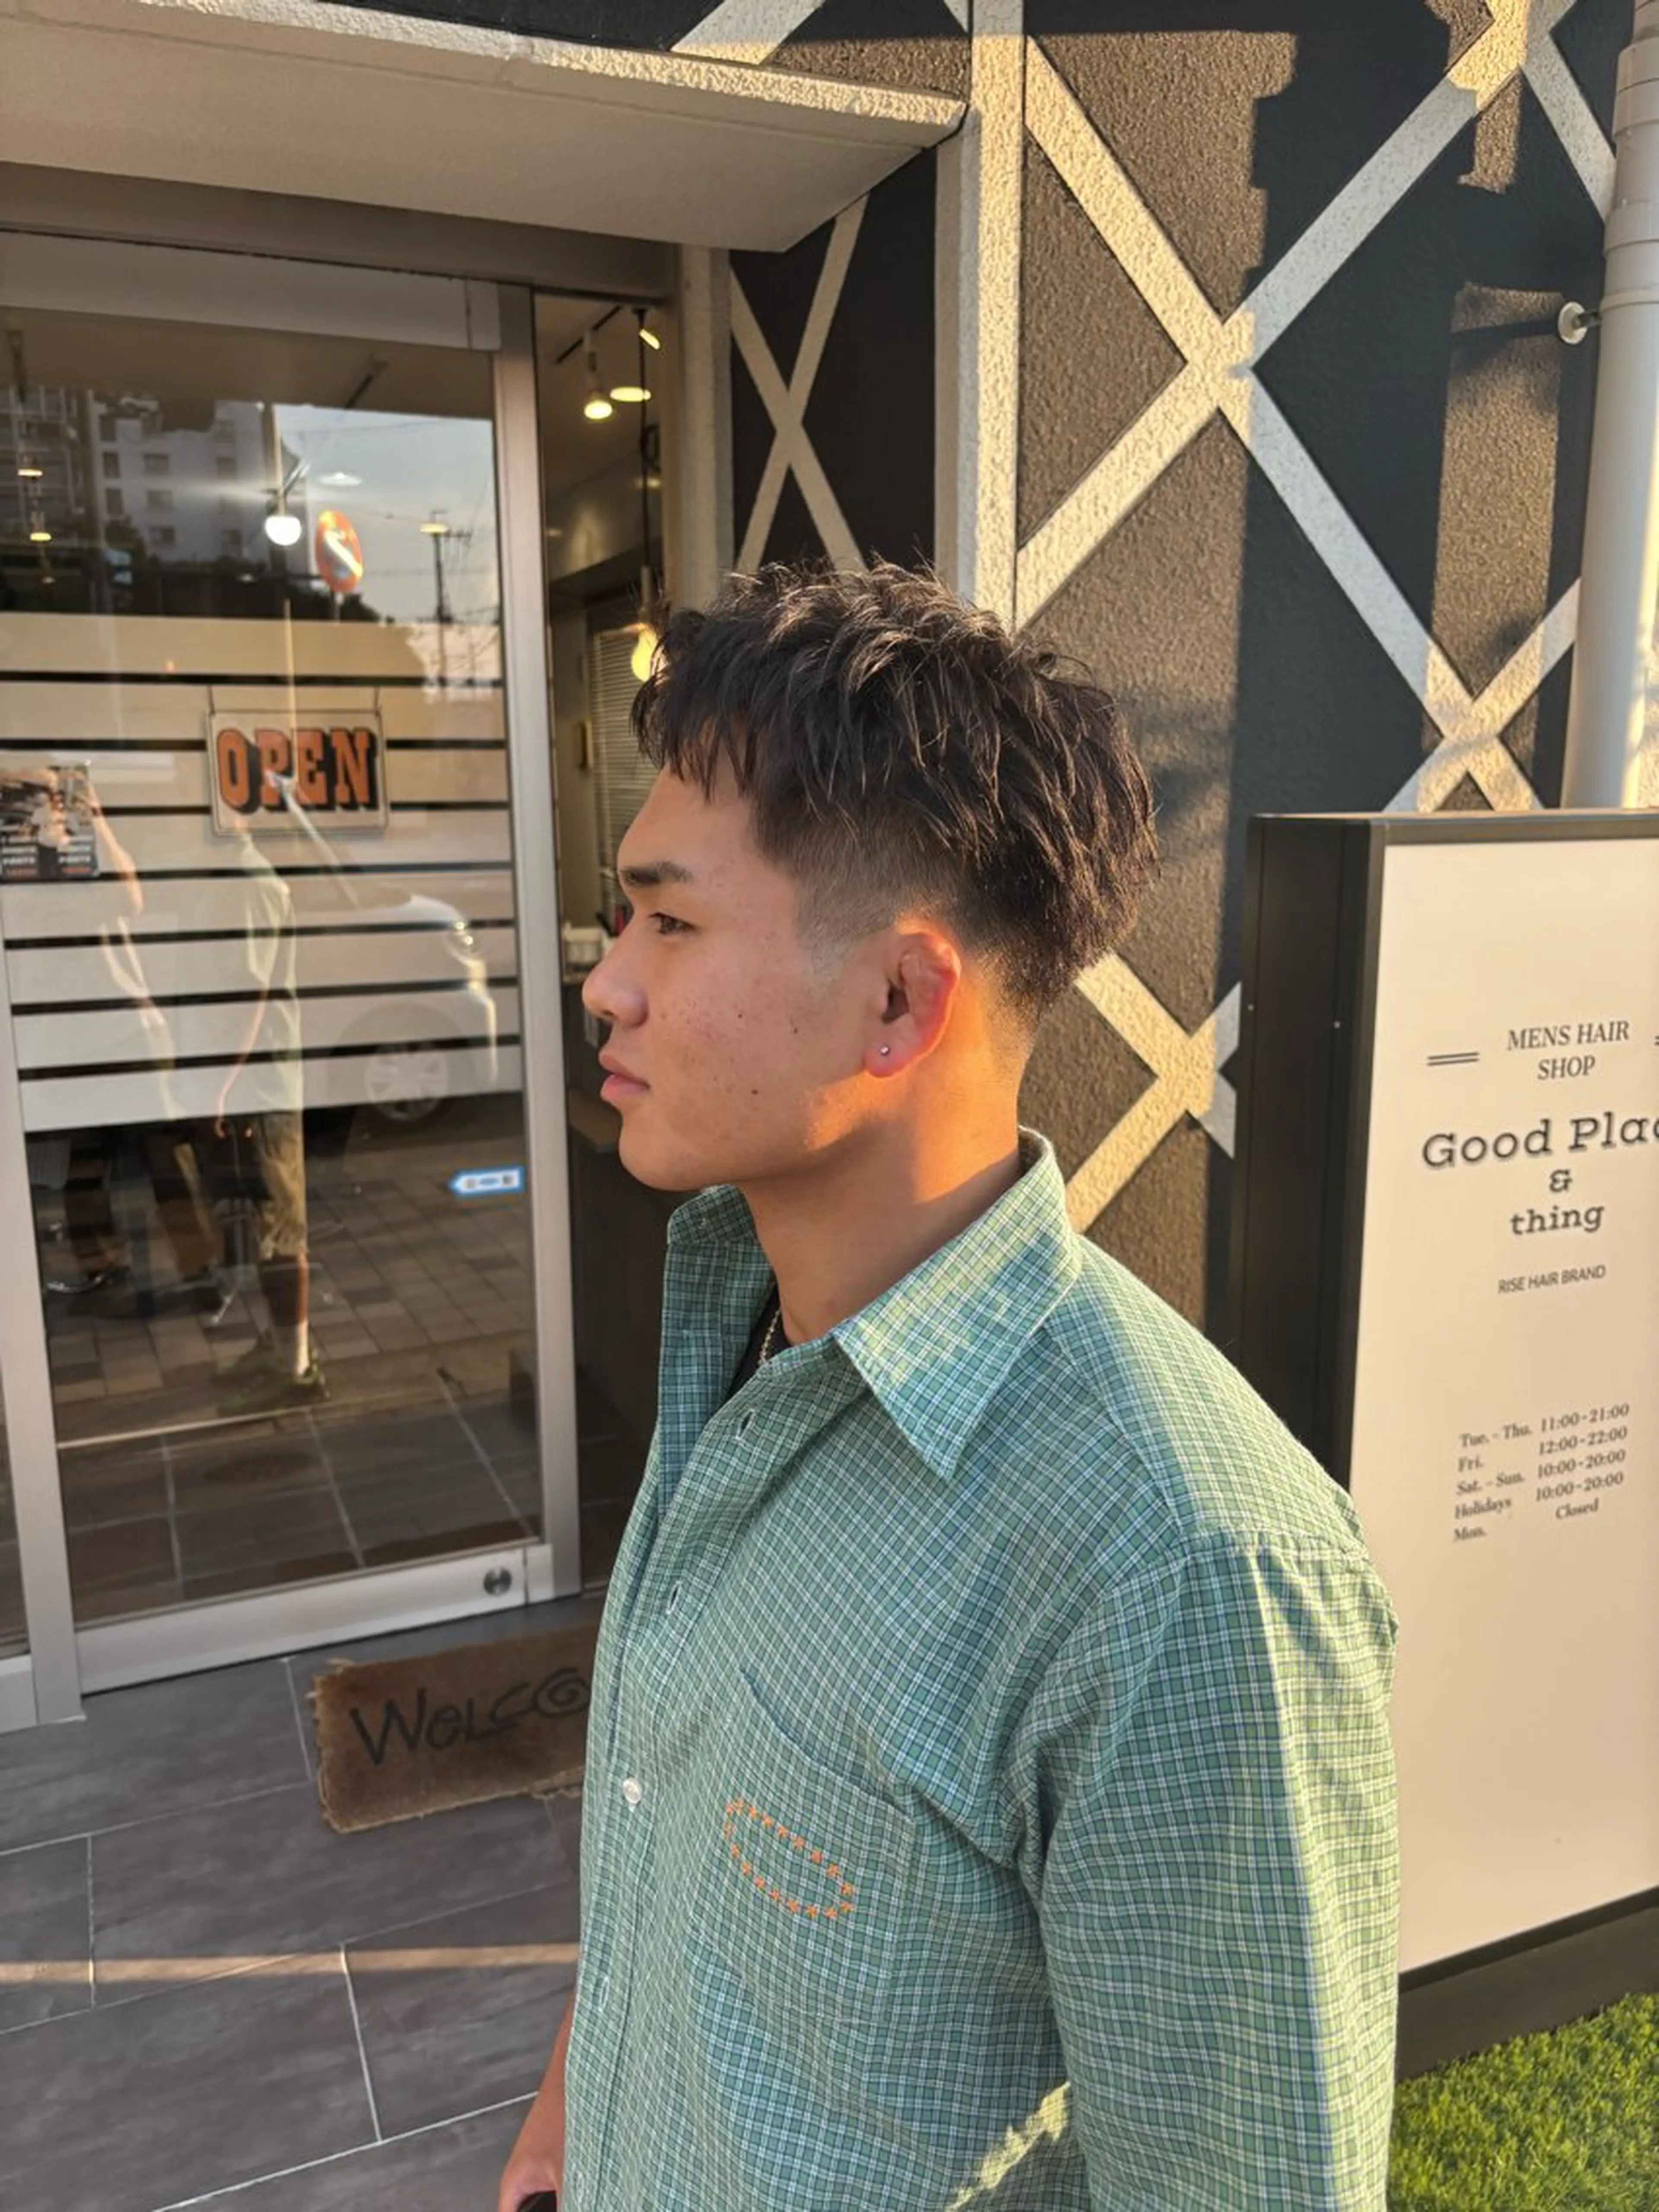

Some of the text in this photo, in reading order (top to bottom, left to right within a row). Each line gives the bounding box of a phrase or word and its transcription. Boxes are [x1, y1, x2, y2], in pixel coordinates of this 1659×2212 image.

[217, 727, 375, 814] OPEN
[1507, 1020, 1630, 1050] MENS HAIR
[1537, 1055, 1595, 1080] SHOP
[1422, 1112, 1659, 1167] Good Pla
[1549, 1169, 1572, 1192] &
[1510, 1205, 1604, 1235] thing
[1498, 1264, 1606, 1294] RISE HAIR BRAND
[1458, 1456, 1484, 1472] Fri.
[1454, 1497, 1511, 1519] Holidays
